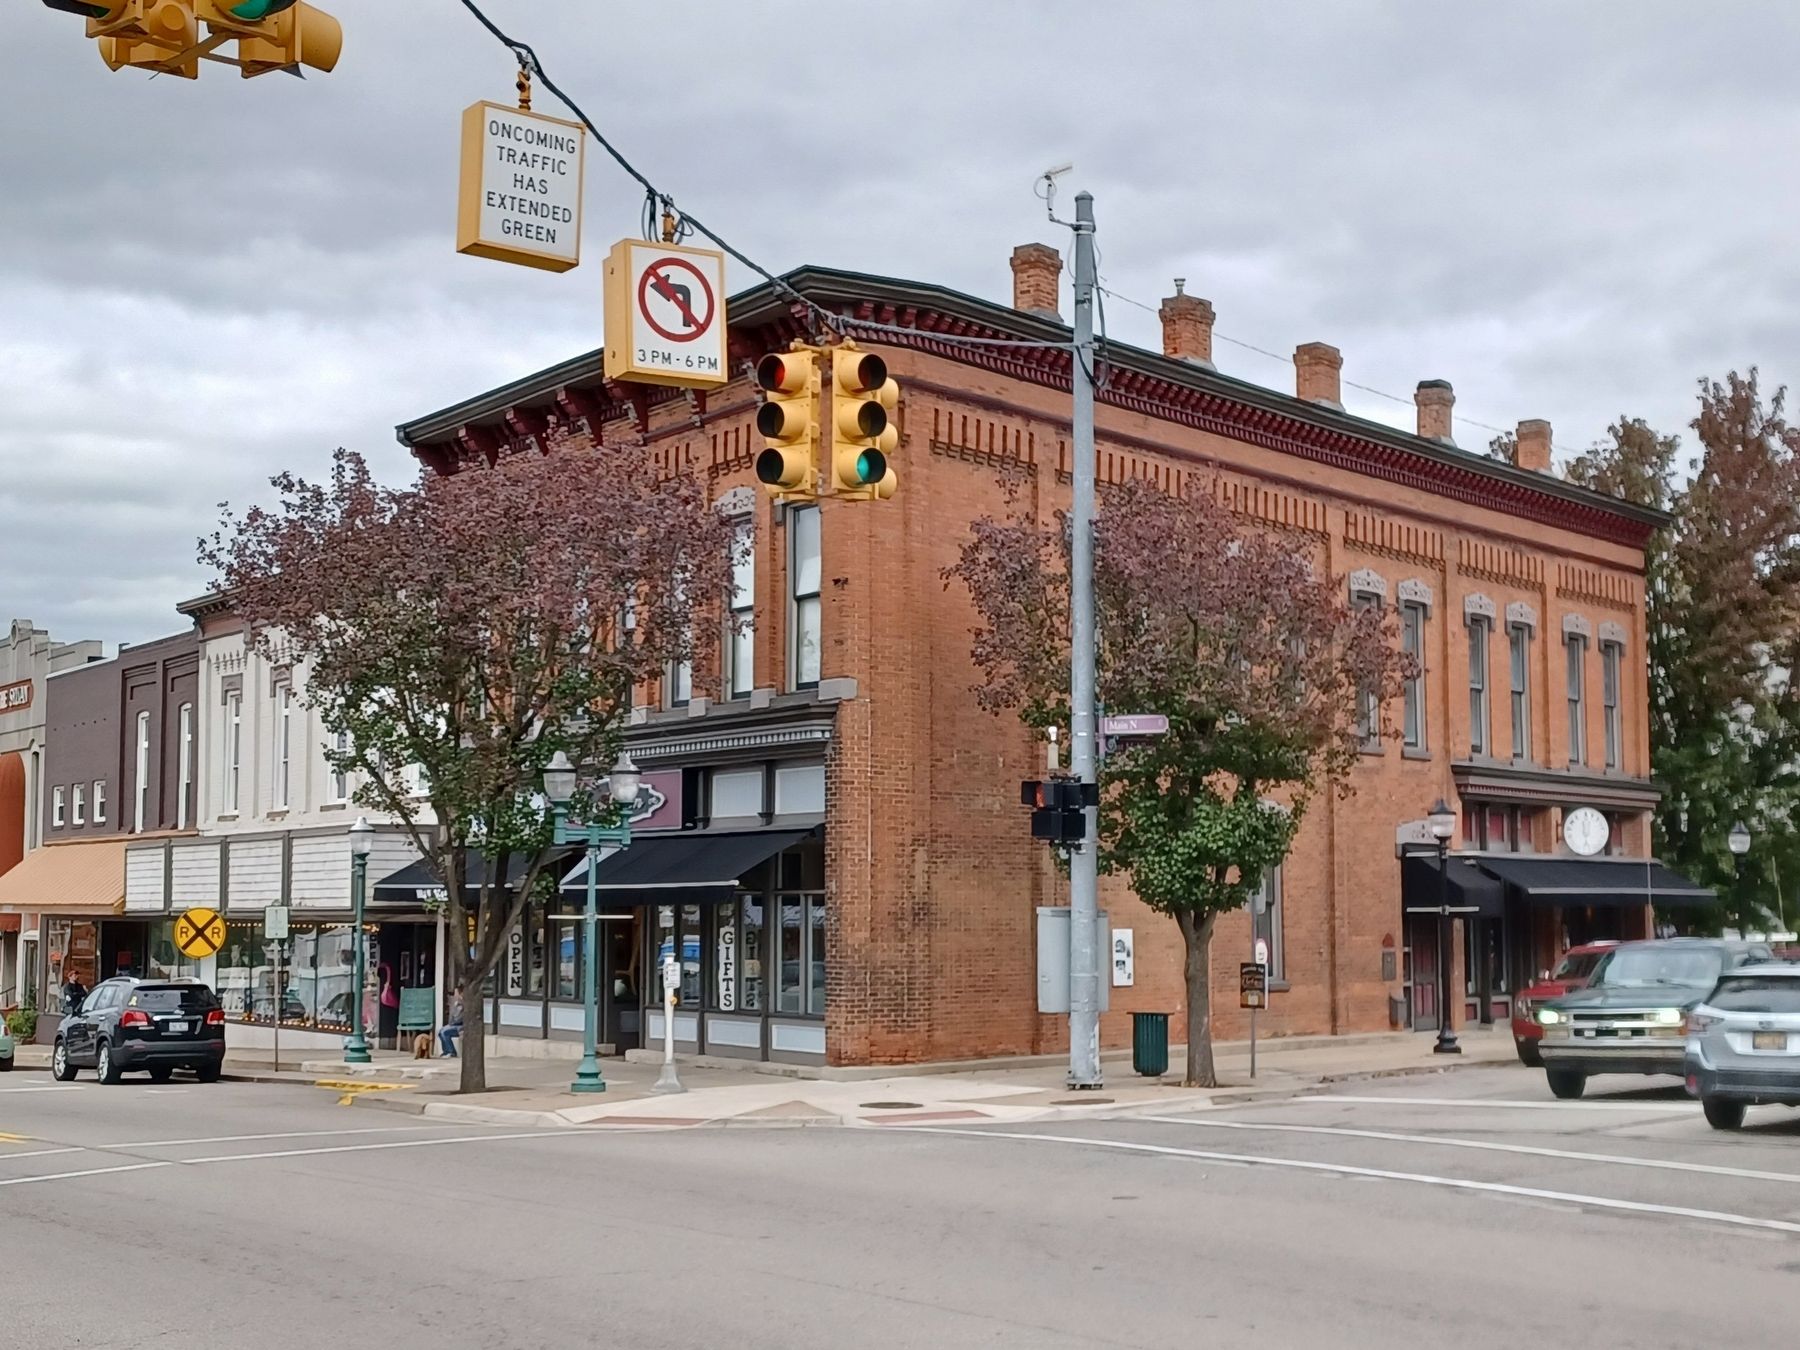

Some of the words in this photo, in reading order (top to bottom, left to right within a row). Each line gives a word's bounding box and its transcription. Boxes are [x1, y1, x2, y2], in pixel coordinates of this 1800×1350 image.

[488, 120, 576, 154] ONCOMING
[497, 145, 567, 176] TRAFFIC
[513, 173, 548, 195] HAS
[487, 191, 572, 224] EXTENDED
[501, 219, 557, 244] GREEN
[1109, 720, 1128, 730] Main
[179, 926, 188, 938] R
[211, 926, 221, 938] R
[510, 932, 522, 988] OPEN
[722, 931, 735, 1008] GIFTS
